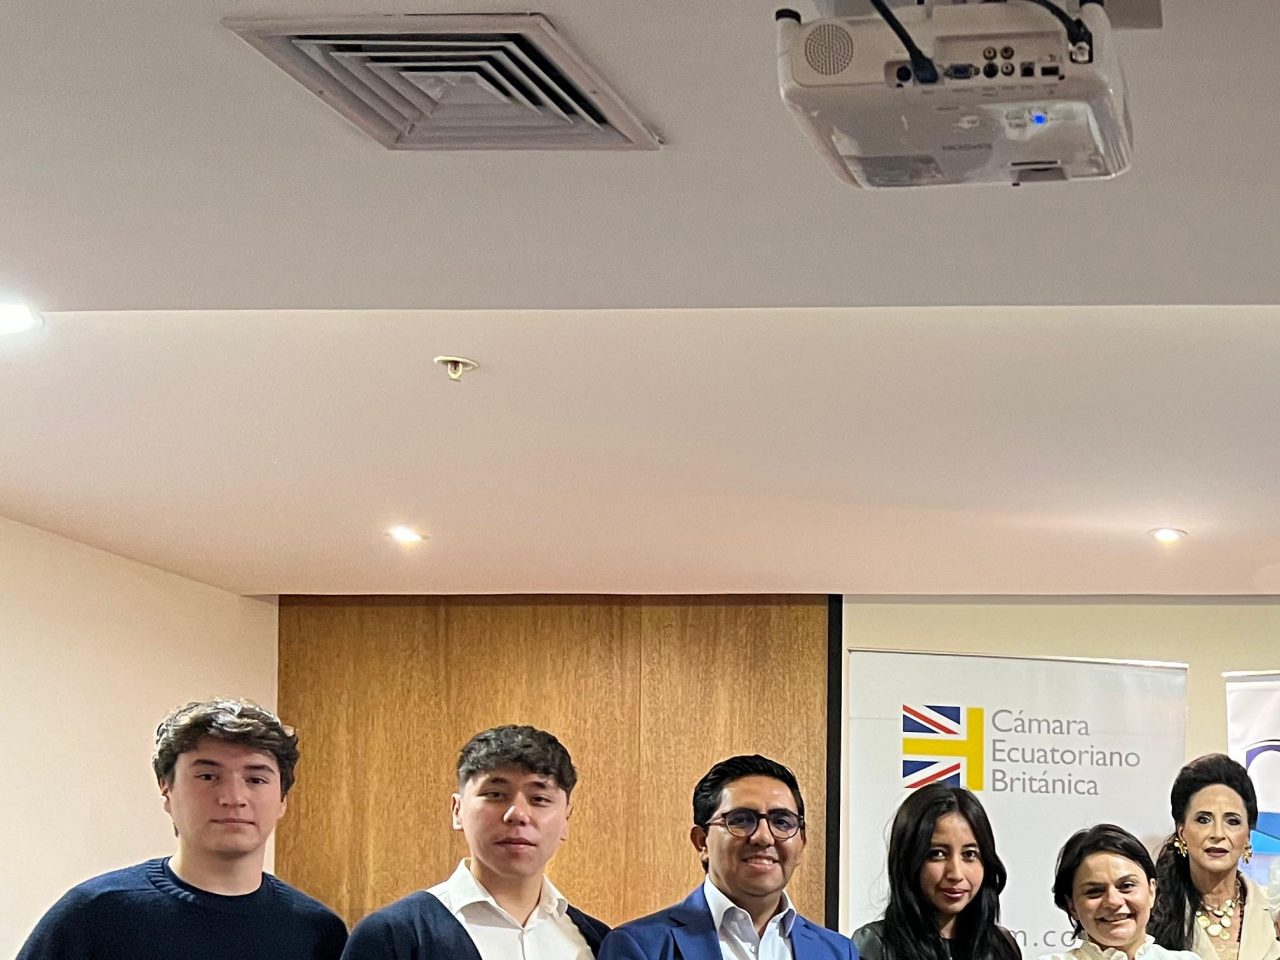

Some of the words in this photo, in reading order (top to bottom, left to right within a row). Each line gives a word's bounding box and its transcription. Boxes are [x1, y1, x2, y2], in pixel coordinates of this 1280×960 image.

[991, 709, 1090, 736] Cámara
[991, 738, 1141, 767] Ecuatoriano
[991, 768, 1099, 795] Británica
